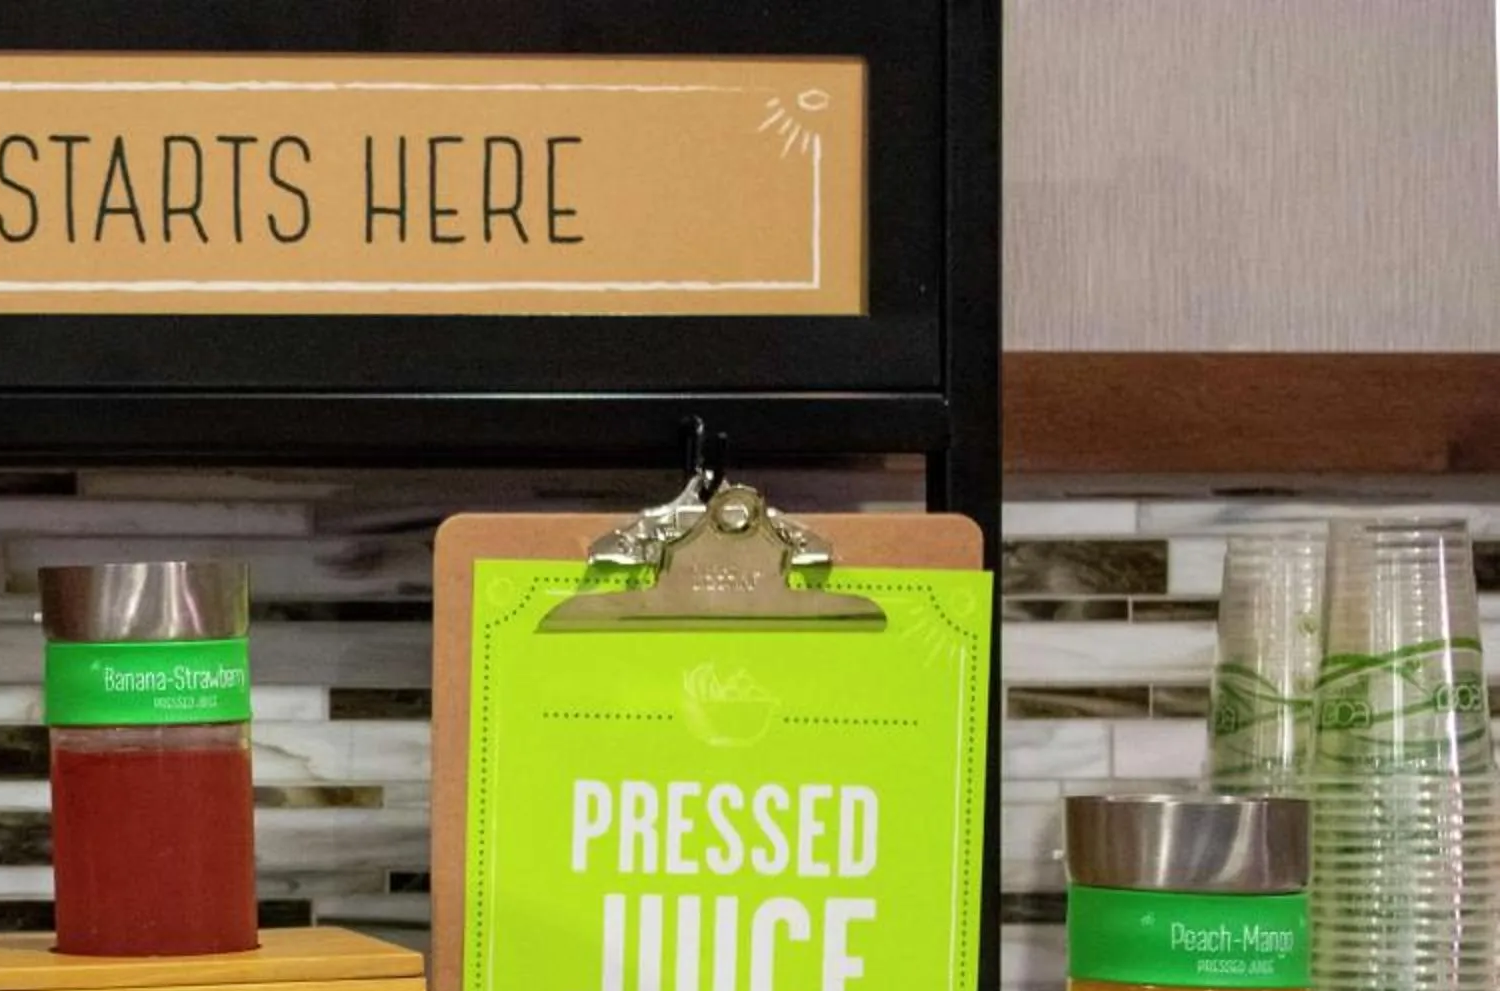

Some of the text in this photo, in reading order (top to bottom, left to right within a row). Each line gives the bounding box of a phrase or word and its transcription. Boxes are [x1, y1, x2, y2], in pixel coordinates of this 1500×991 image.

[365, 135, 584, 244] HERE
[571, 779, 878, 877] PRESSED
[1171, 922, 1295, 960] Peach-Mango
